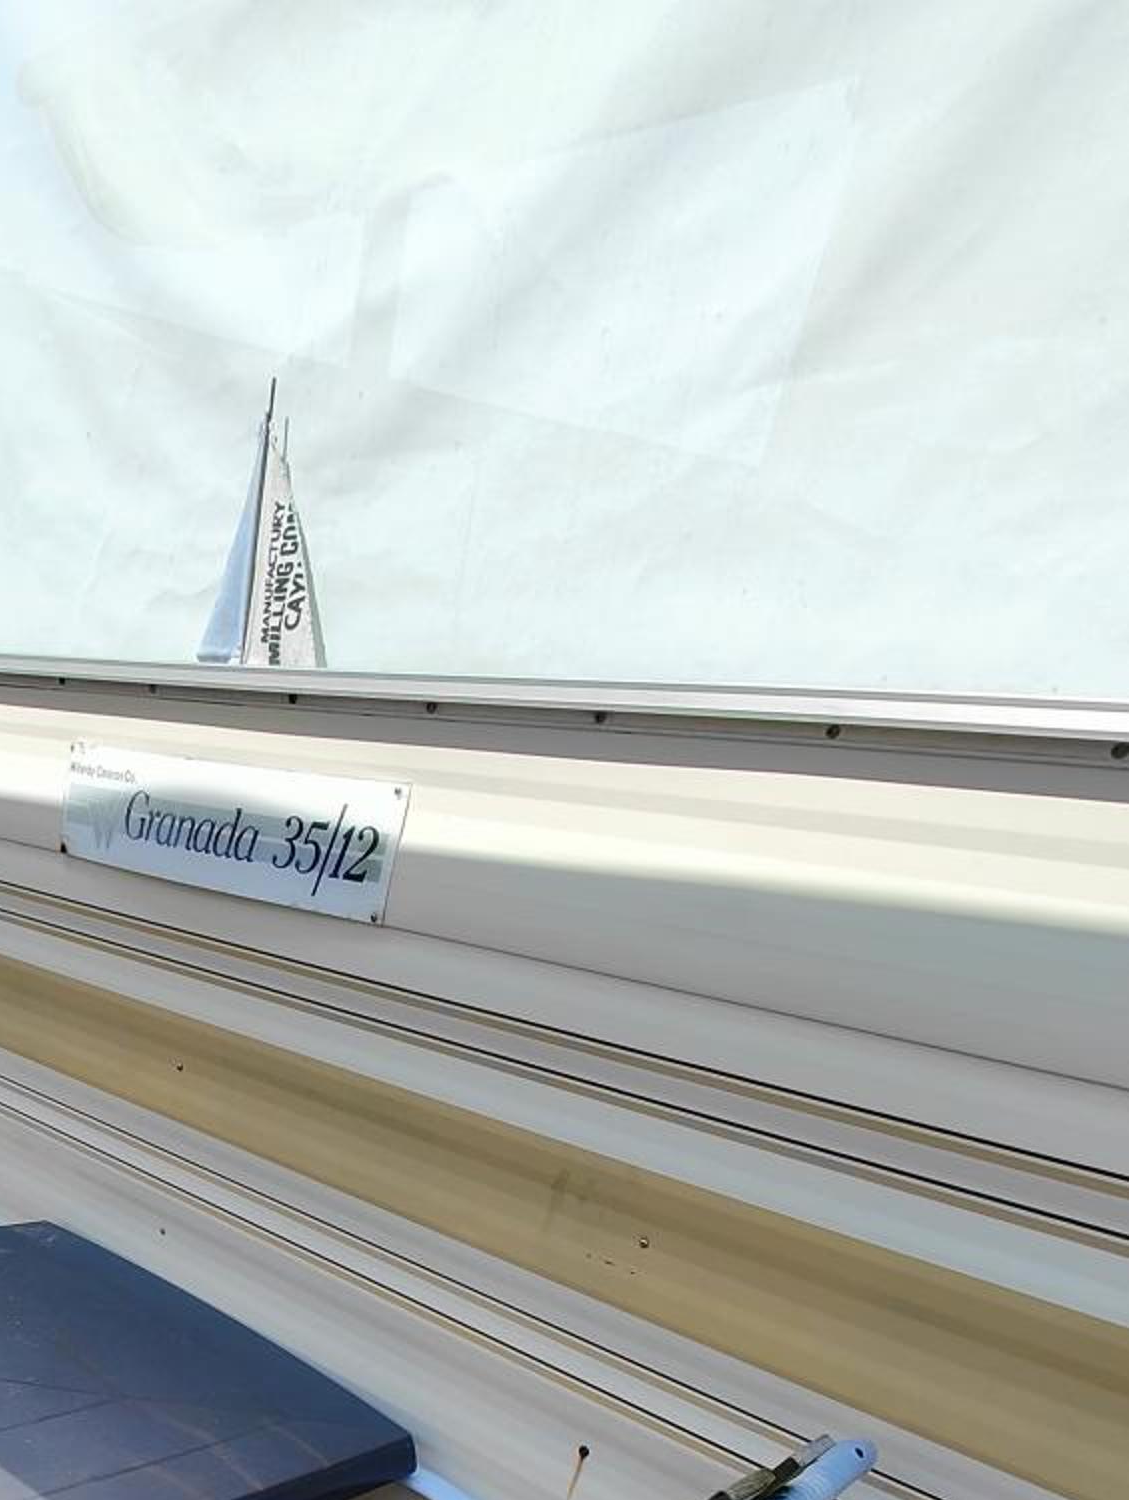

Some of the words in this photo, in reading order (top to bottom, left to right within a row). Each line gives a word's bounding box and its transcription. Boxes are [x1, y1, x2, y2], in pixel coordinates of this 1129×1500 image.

[260, 501, 286, 644] MANUFACTURY
[268, 561, 295, 667] MILLING
[124, 789, 259, 864] Granada
[272, 803, 380, 897] 35/12
